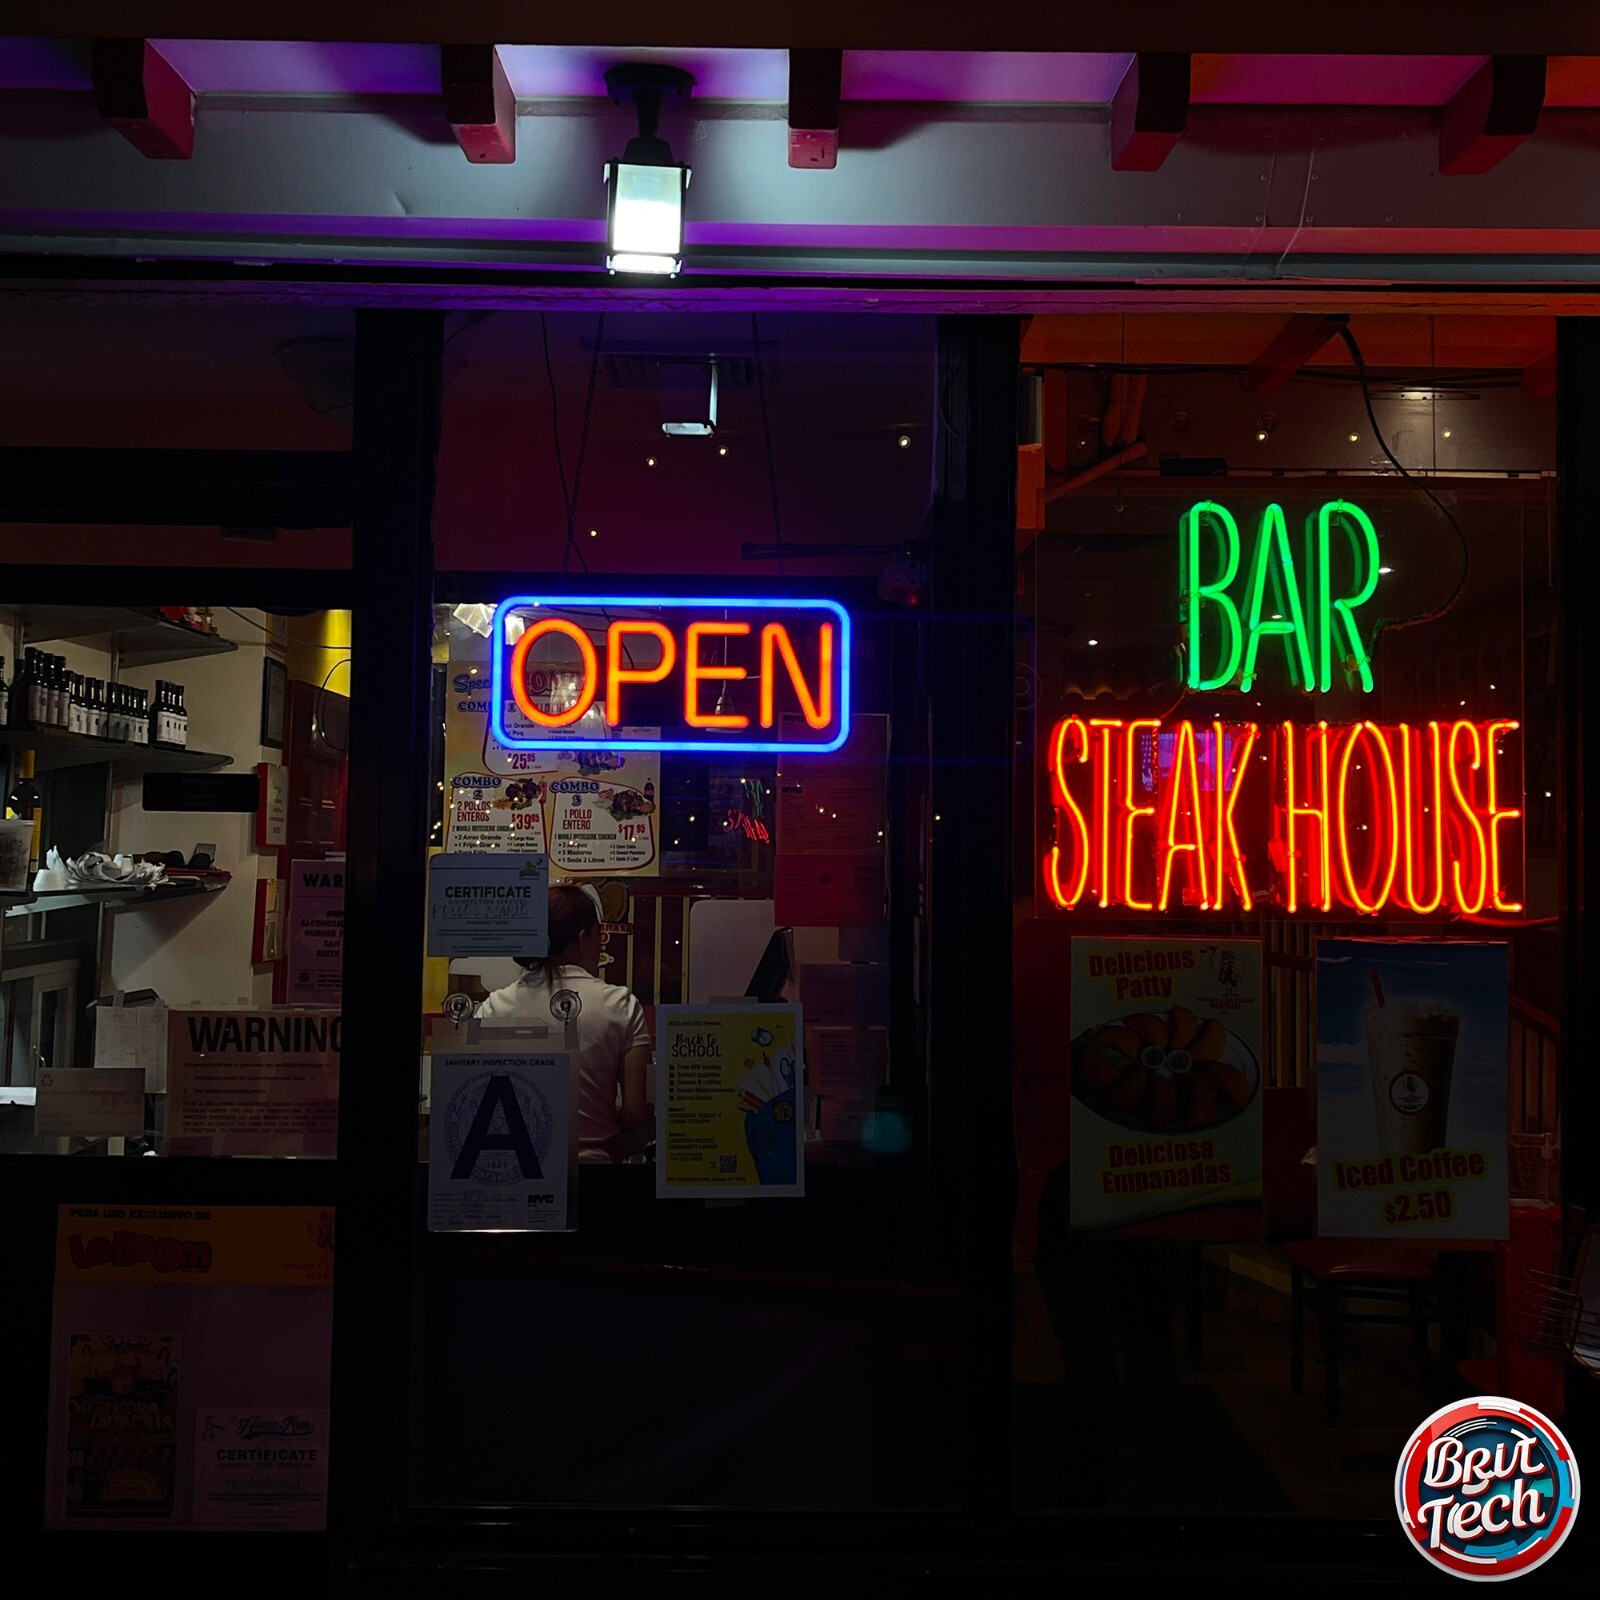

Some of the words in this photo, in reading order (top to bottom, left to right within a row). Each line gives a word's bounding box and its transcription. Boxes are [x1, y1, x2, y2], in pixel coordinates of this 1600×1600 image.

[1182, 500, 1381, 694] BAR
[511, 617, 833, 729] OPEN
[454, 675, 491, 696] Spec
[458, 701, 491, 712] COM
[452, 776, 501, 787] COMBO
[550, 781, 600, 792] COMBO
[457, 802, 463, 811] 2
[464, 802, 491, 811] POLLOS
[457, 812, 490, 822] ENTEROS
[569, 809, 592, 819] POLLO
[1048, 719, 1259, 912] STEAK
[1281, 719, 1521, 914] HOUSE
[511, 813, 541, 830] $39.95
[562, 820, 591, 830] ENTERO
[618, 823, 646, 841] $1795
[445, 886, 532, 898] CERTIFICATE
[1089, 950, 1194, 977] Delicious
[1115, 977, 1172, 999] Patty
[676, 1033, 705, 1046] Back
[706, 1033, 718, 1046] to
[671, 1045, 722, 1057] SCHOOL
[444, 1059, 480, 1067] SANITARY
[482, 1059, 528, 1067] INSPECTION
[529, 1059, 555, 1067] GRADE
[450, 1076, 544, 1180] A
[1109, 1140, 1214, 1168] Deliciosa
[1336, 1158, 1394, 1189] Iced
[1400, 1152, 1485, 1183] Coffee
[1102, 1163, 1231, 1194] Empanadas
[527, 1195, 555, 1204] NYC
[1384, 1190, 1452, 1224] $2.50
[70, 1208, 99, 1218] PARA
[103, 1208, 127, 1218] USO
[129, 1209, 193, 1219] EXCLUSIVO
[195, 1210, 212, 1221] DE
[216, 1449, 319, 1461] CERTIFICATE
